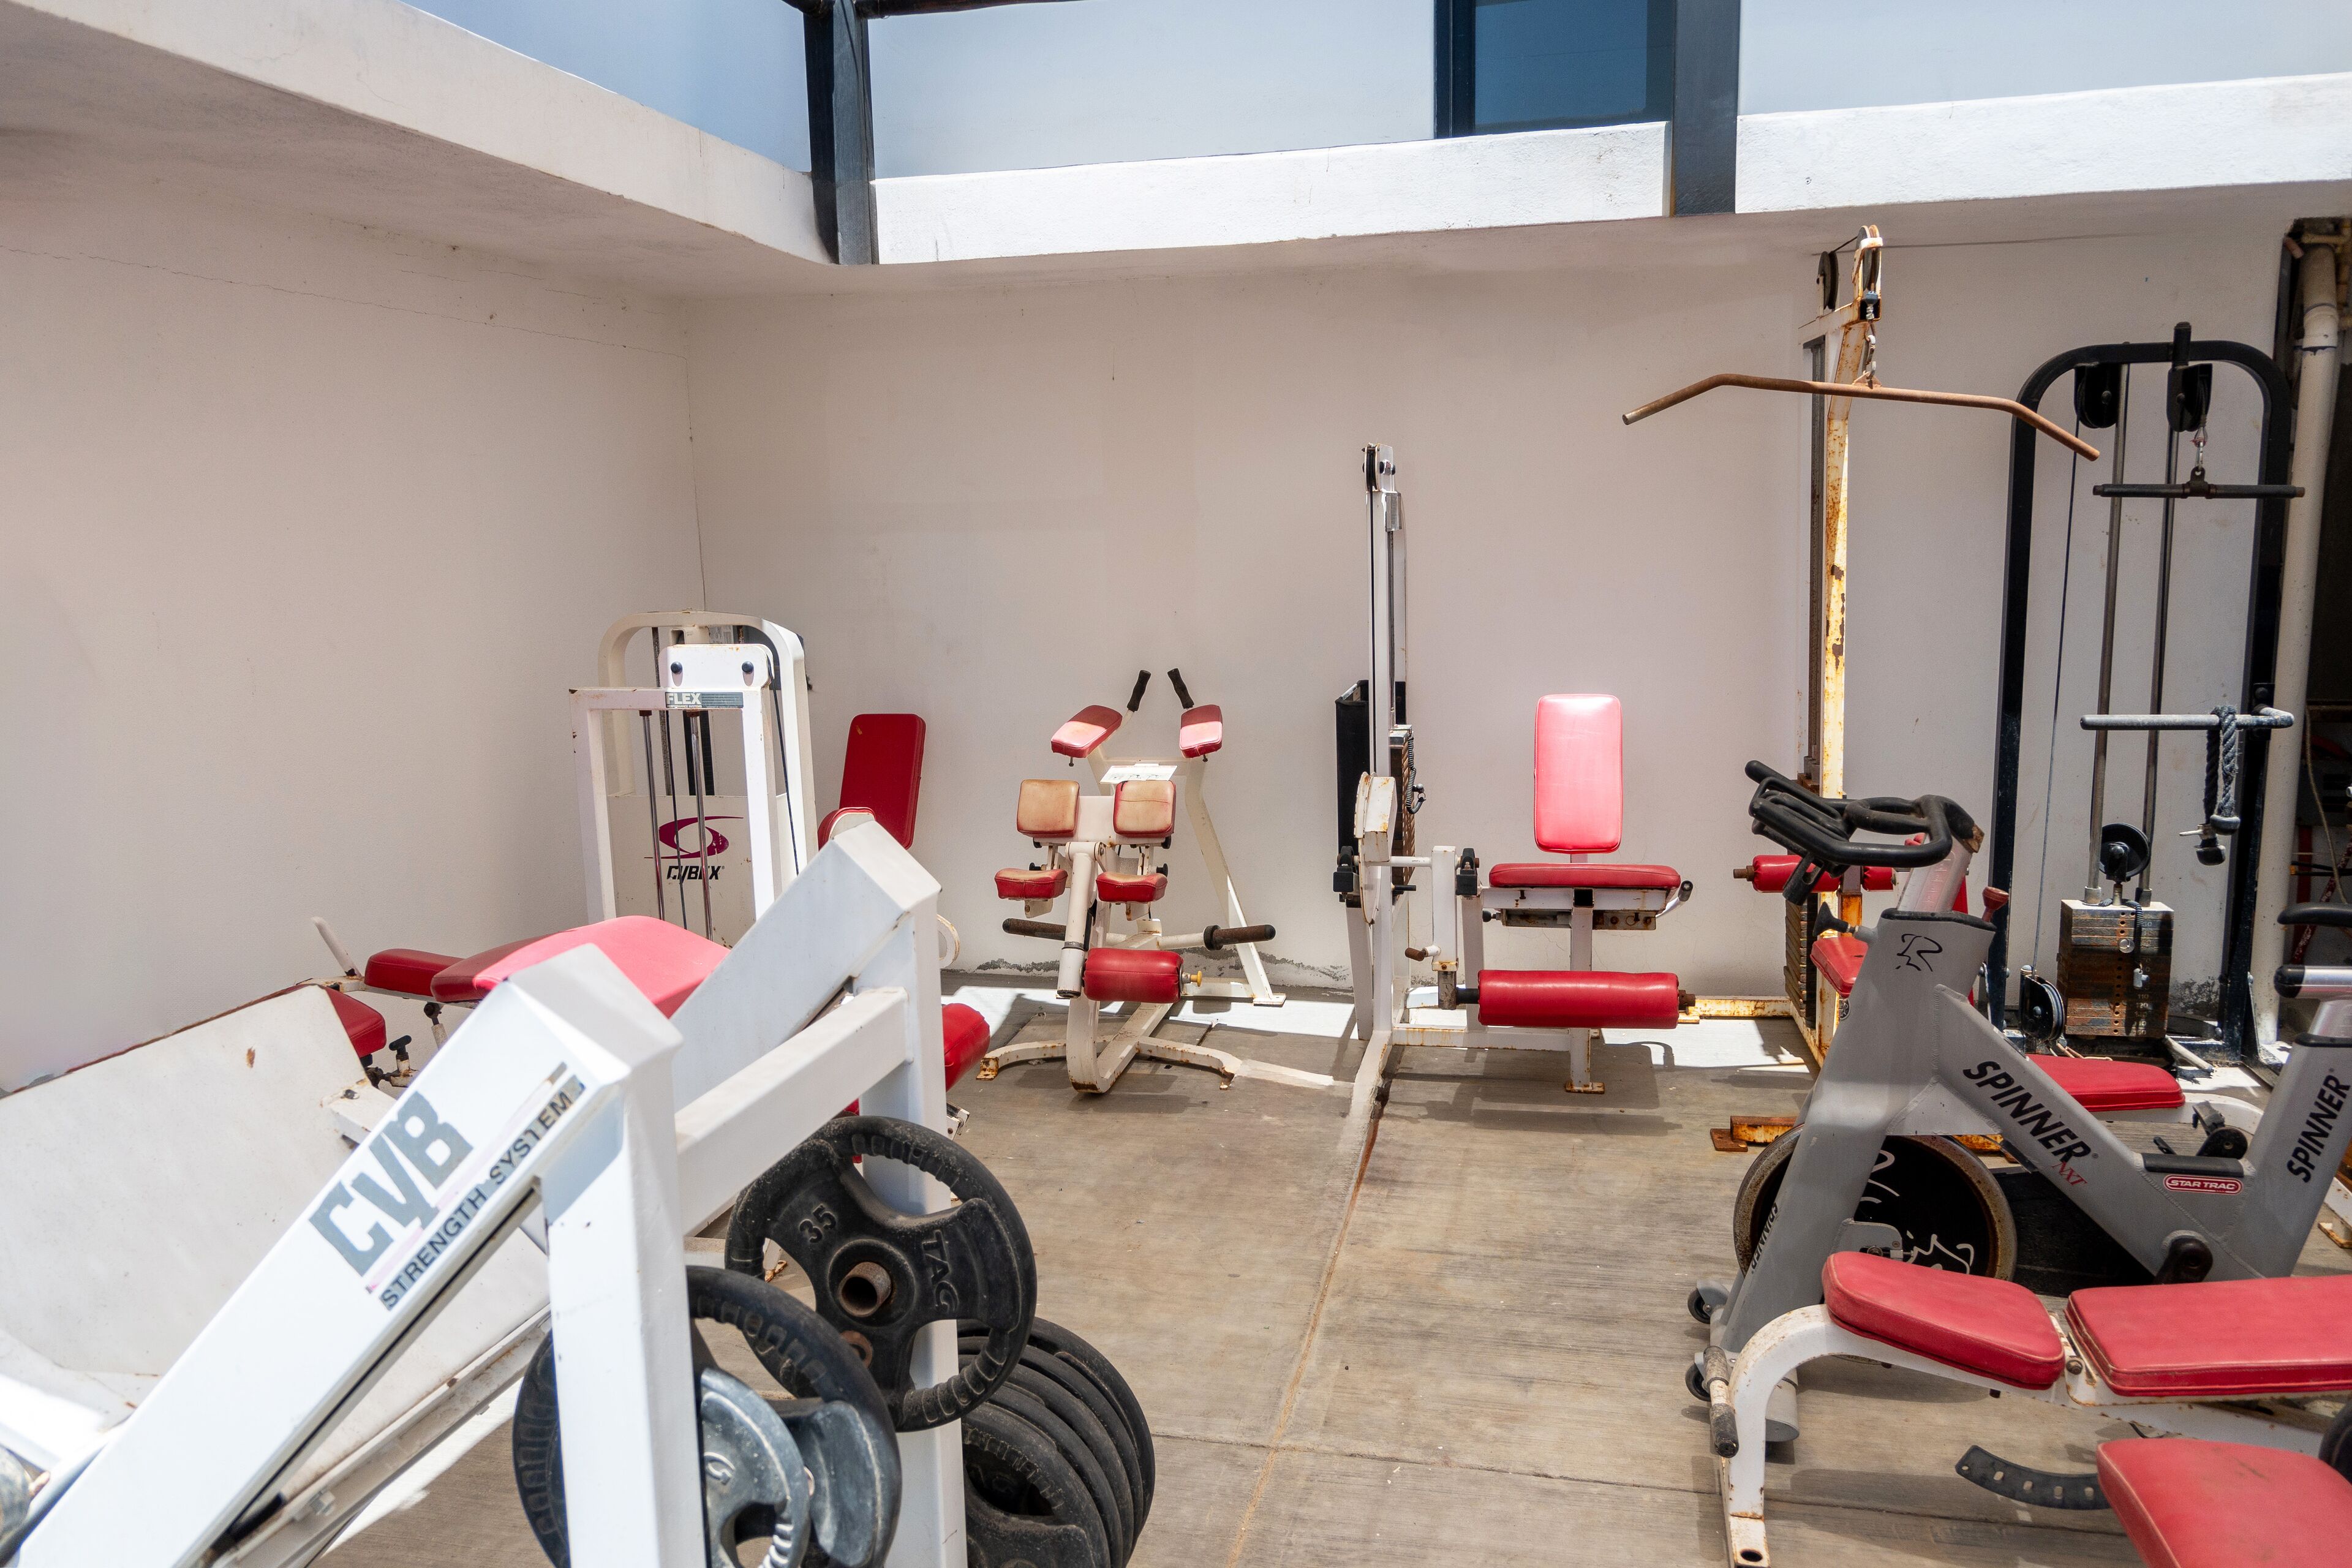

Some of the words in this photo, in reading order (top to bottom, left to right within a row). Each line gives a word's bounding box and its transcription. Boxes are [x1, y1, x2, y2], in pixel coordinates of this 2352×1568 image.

[666, 693, 701, 704] FLEX
[1962, 1061, 2091, 1163] SPINNER
[2286, 1075, 2351, 1183] SPINNER
[2052, 1161, 2087, 1186] NXT
[2203, 1182, 2236, 1190] TRAC
[383, 1187, 488, 1308] STRENGTH
[489, 1083, 585, 1185] SYSTEM
[799, 1204, 837, 1244] 35
